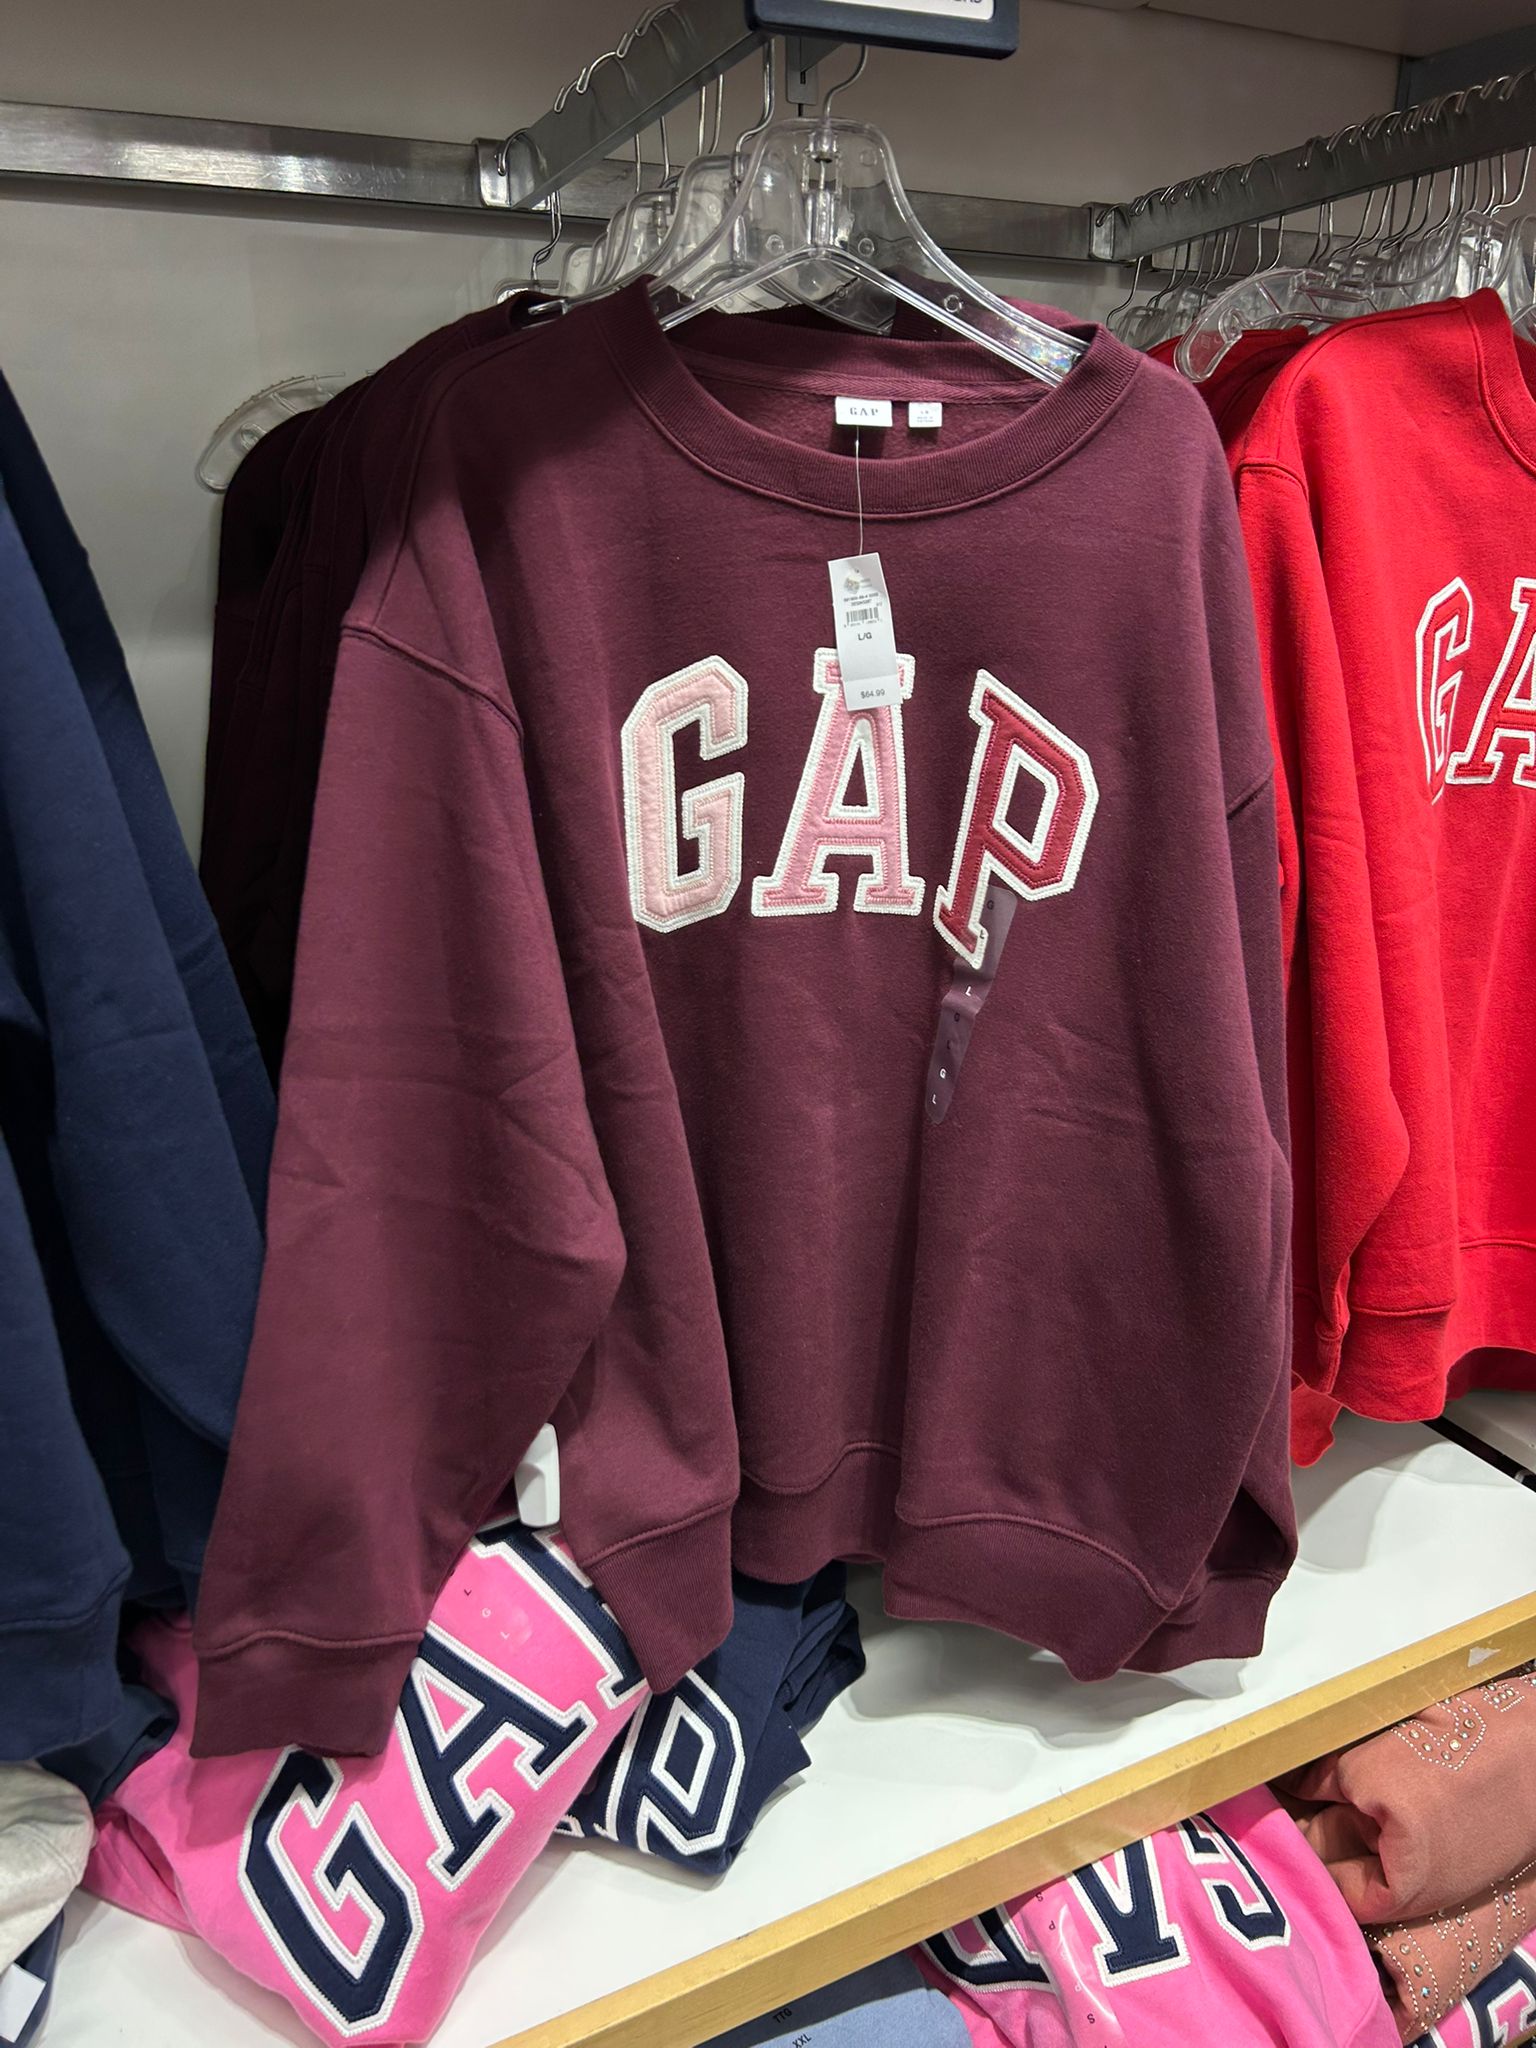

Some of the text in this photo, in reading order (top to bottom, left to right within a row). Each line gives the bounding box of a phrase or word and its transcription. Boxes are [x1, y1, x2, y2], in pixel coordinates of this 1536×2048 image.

[849, 407, 879, 417] GAP
[860, 688, 886, 699] $64.99
[620, 647, 1100, 970] GAP
[986, 900, 995, 911] G
[965, 986, 972, 997] L
[939, 1068, 947, 1079] G
[481, 1607, 492, 1619] G
[1048, 1920, 1056, 1931] P
[772, 2007, 793, 2023] TTG
[1086, 2013, 1096, 2024] S
[792, 2033, 812, 2048] XXL
